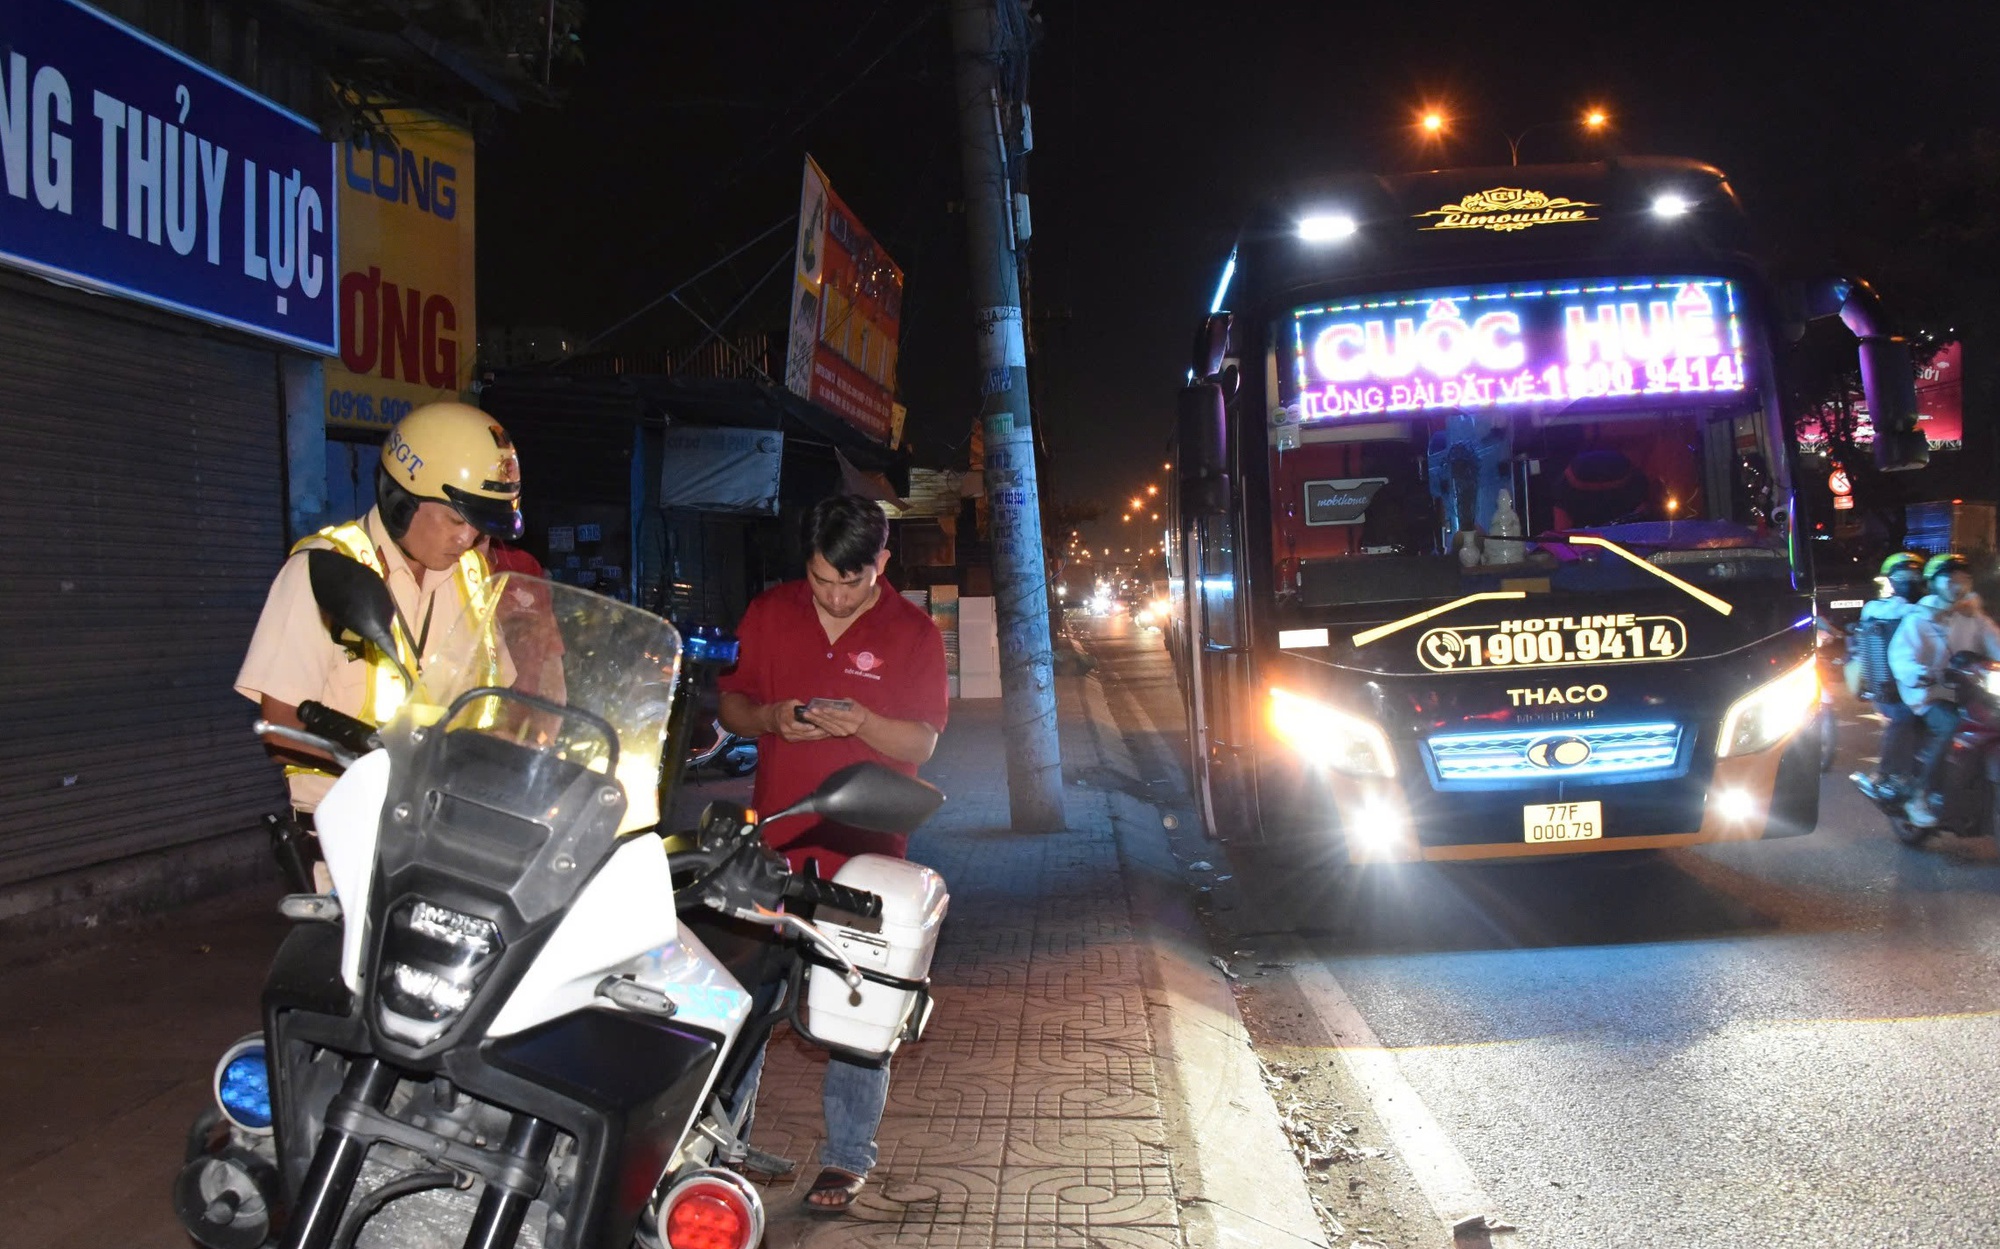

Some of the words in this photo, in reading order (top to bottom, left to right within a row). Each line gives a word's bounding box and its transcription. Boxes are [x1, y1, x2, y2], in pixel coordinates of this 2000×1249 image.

[94, 84, 229, 266] THỦY
[244, 158, 324, 315] LỰC
[1435, 209, 1587, 227] Limousine
[1317, 494, 1369, 508] mobihome
[1500, 613, 1636, 634] HOTLINE
[1463, 625, 1675, 667] 1900.9414
[1506, 684, 1608, 706] THACO
[1546, 804, 1579, 822] 77F
[1533, 822, 1593, 840] 000.79
